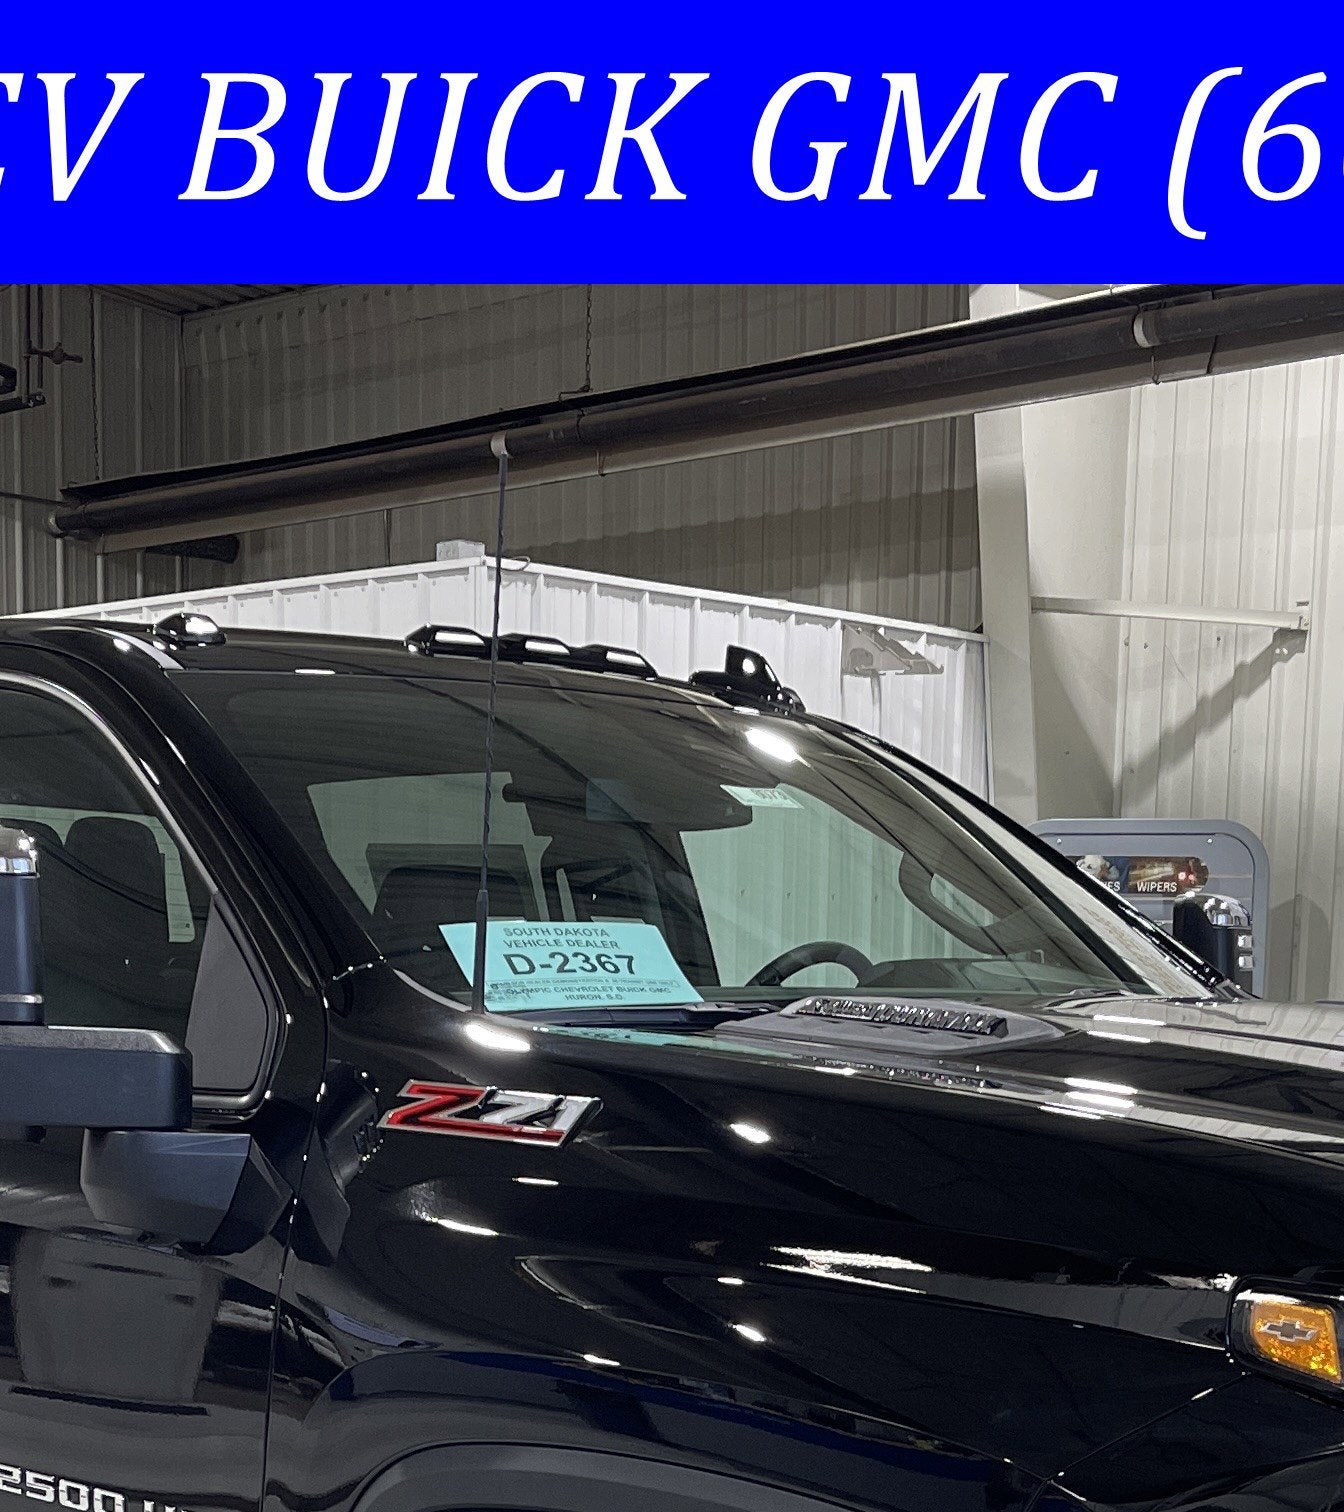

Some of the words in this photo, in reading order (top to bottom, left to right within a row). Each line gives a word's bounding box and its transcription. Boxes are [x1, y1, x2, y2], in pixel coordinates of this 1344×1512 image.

[1136, 881, 1177, 892] WIPERS
[503, 927, 552, 937] SOUTH
[553, 927, 610, 938] DAKOTA
[503, 939, 564, 948] VEHICLE
[566, 939, 621, 950] DEALER
[503, 951, 636, 975] D-2367
[376, 1078, 603, 1148] Z71
